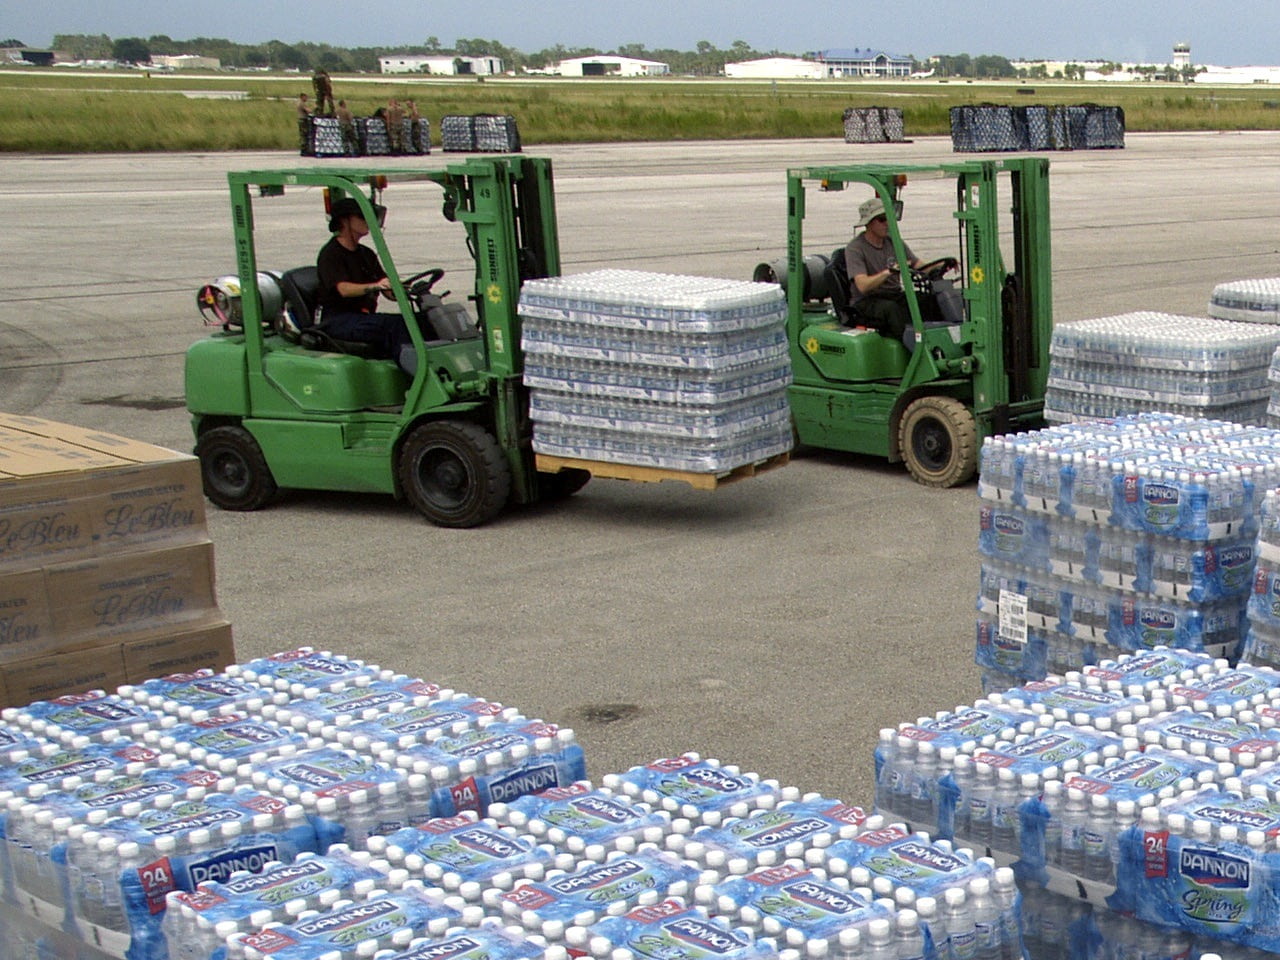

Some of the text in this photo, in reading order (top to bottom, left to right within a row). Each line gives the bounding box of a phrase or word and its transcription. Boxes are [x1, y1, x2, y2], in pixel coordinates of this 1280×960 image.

[455, 787, 474, 804] 24
[491, 765, 557, 802] DANNON
[746, 818, 827, 844] DANNON
[1146, 837, 1163, 854] 24
[192, 845, 278, 884] DANNON
[898, 843, 968, 872] DANNON
[1183, 850, 1249, 878] DANNON
[143, 866, 169, 886] 24
[232, 862, 322, 894] DANNON
[554, 861, 638, 893] DANNON
[788, 883, 865, 913] DANNON
[1181, 888, 1245, 924] Spring
[300, 902, 397, 935] DANNON
[246, 931, 278, 947] 24
